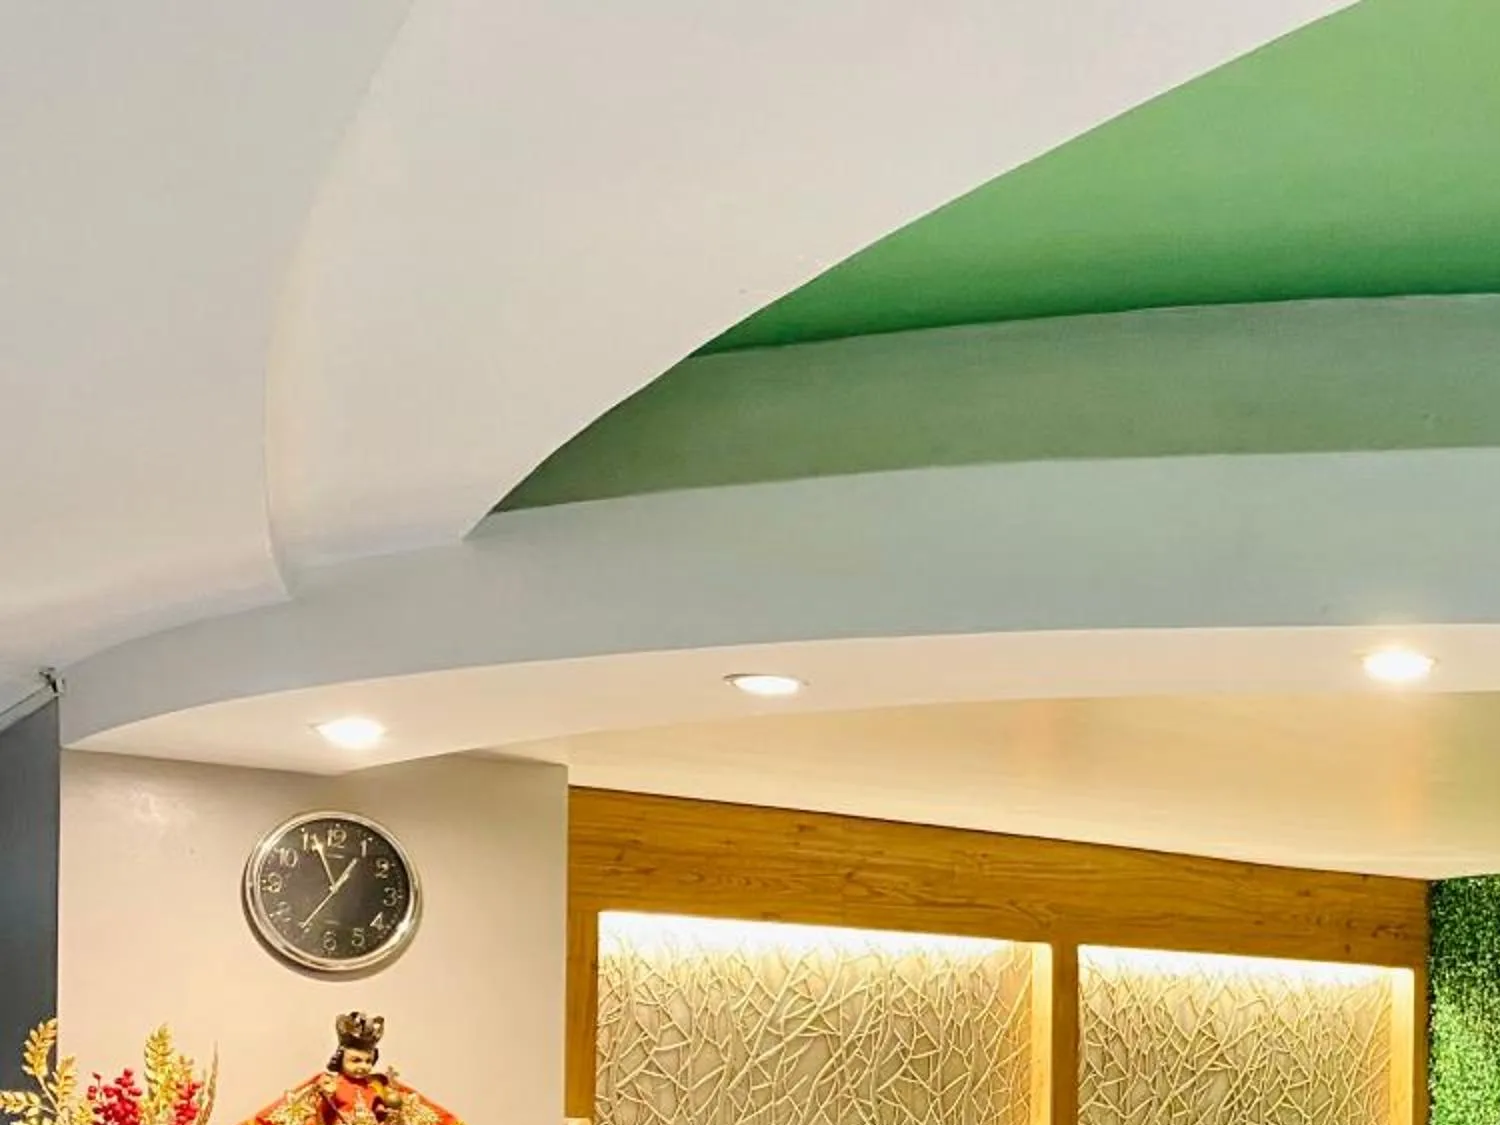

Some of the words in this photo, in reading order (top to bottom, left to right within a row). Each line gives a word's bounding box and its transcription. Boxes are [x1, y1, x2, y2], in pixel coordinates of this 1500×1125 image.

[327, 829, 347, 848] 12
[359, 840, 367, 857] 1
[276, 847, 298, 868] 10
[375, 858, 389, 879] 2
[268, 872, 283, 893] 9
[383, 887, 397, 906] 3
[369, 911, 385, 930] 4
[323, 930, 337, 951] 6
[351, 927, 365, 947] 5
